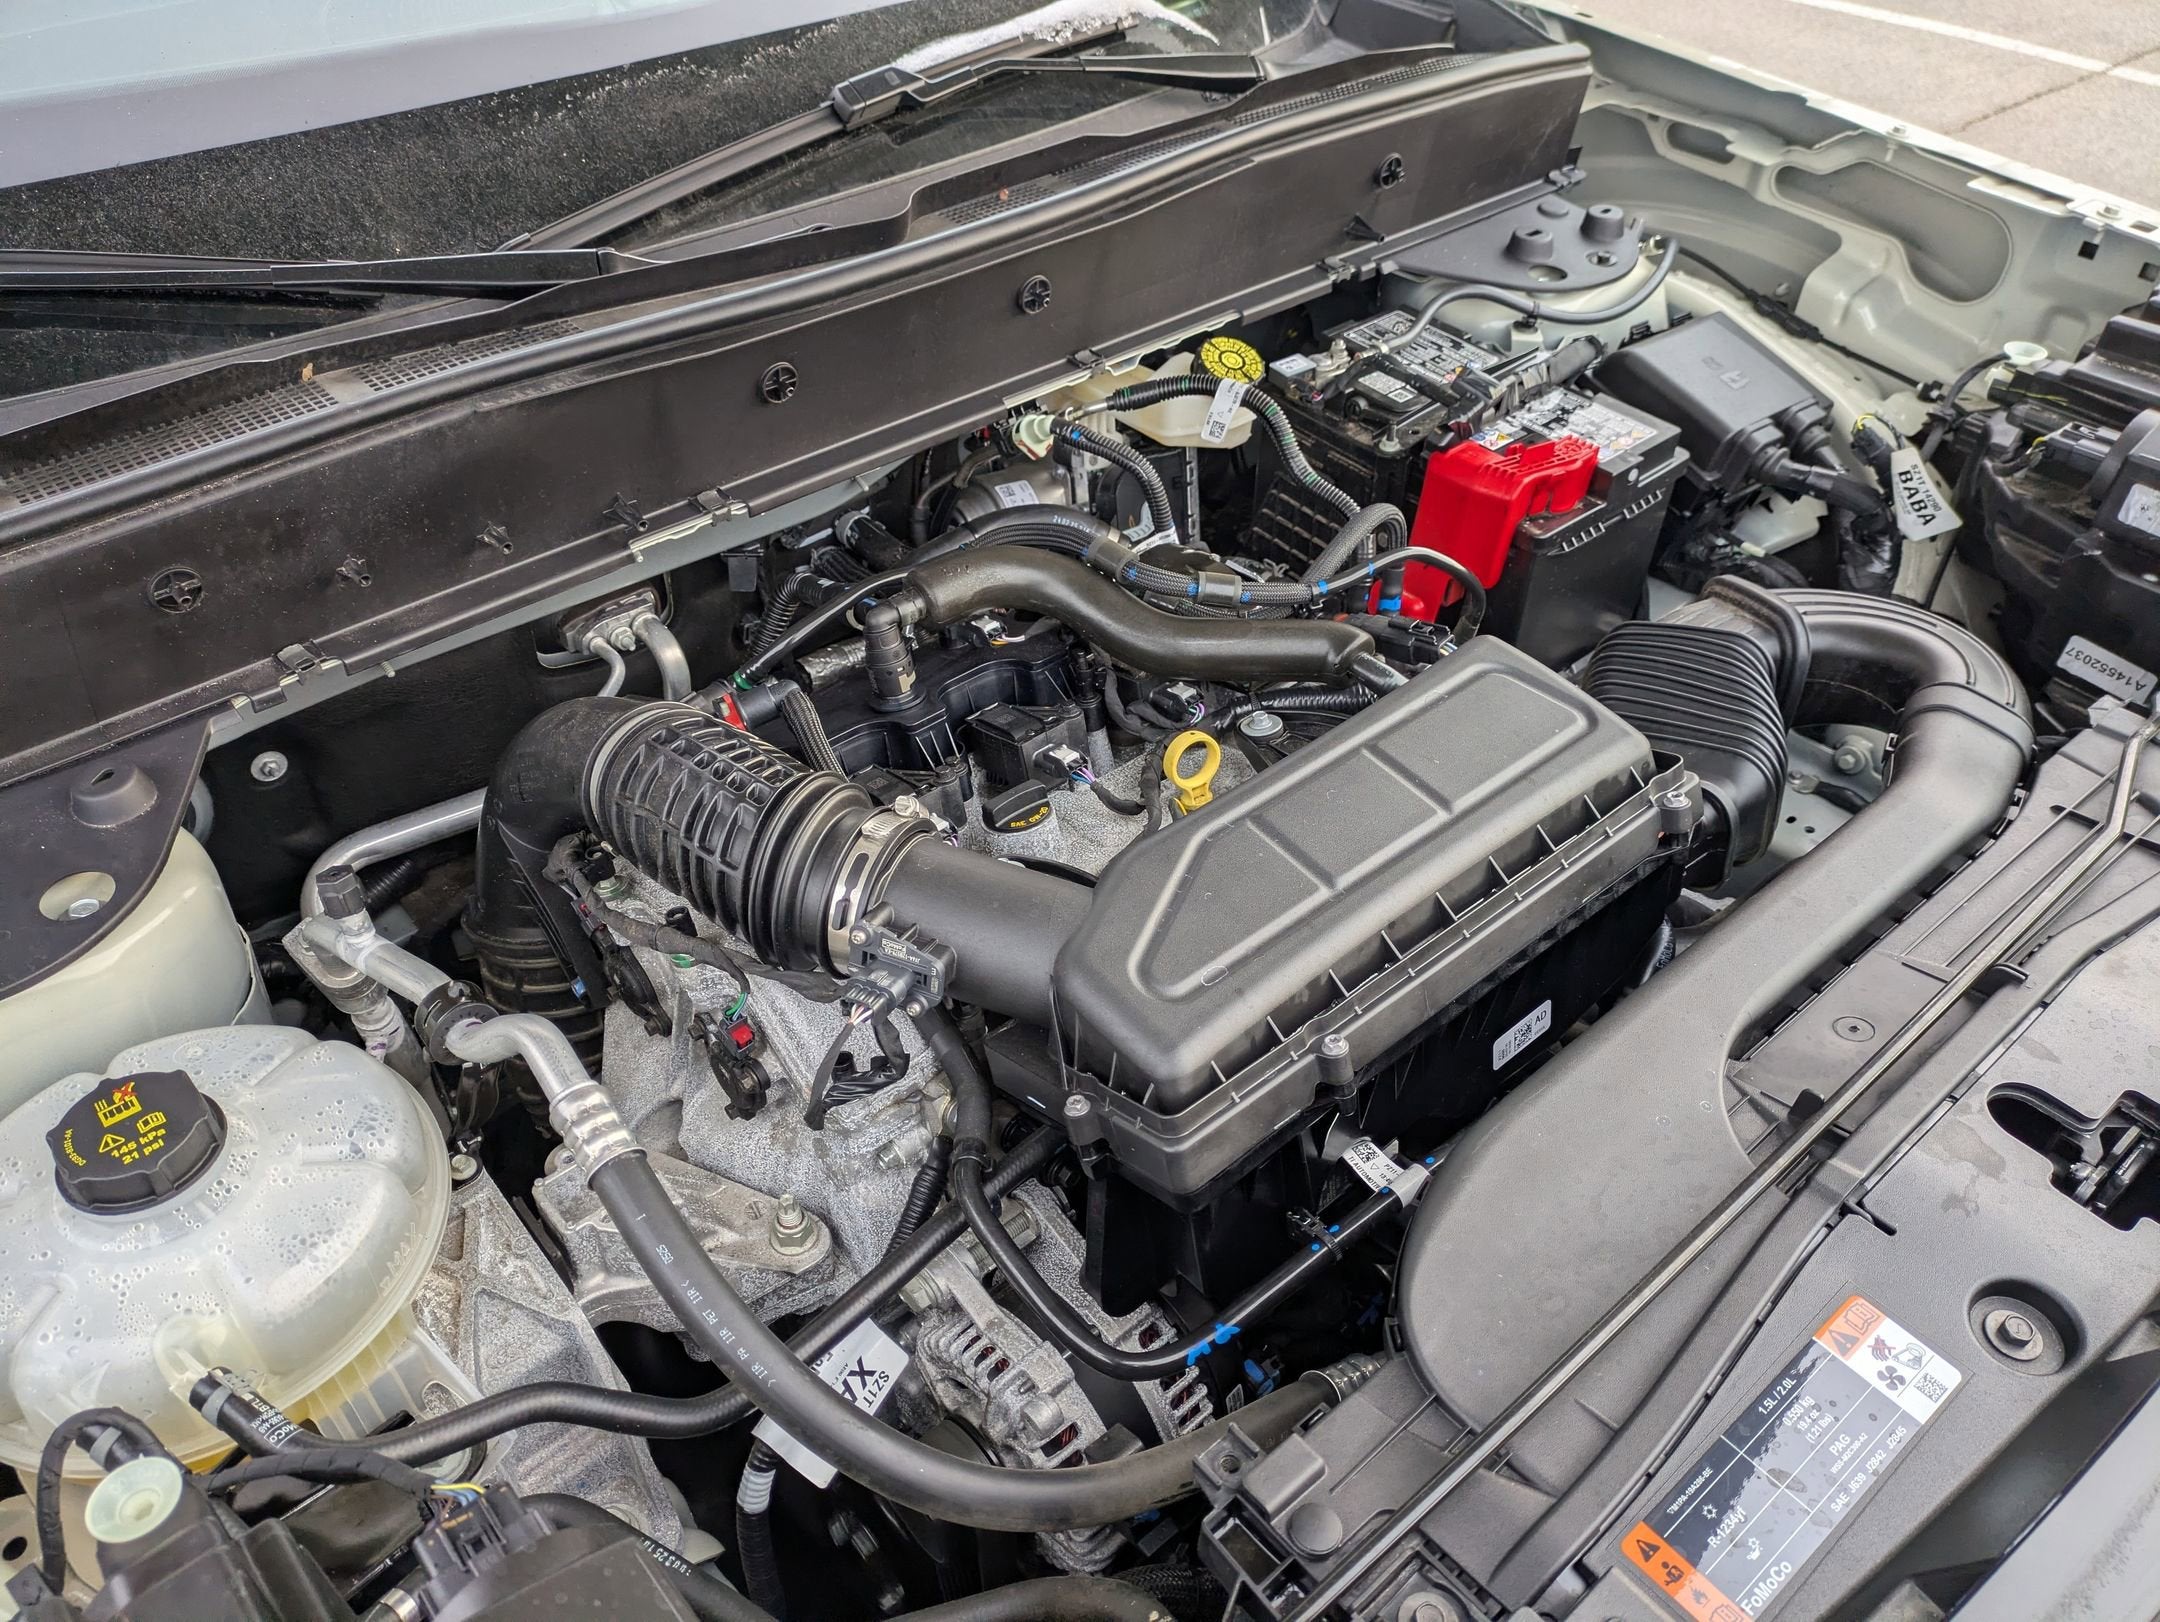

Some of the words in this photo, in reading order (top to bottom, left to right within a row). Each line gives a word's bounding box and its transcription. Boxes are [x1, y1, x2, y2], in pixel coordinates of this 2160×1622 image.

[1897, 470, 1937, 527] BABA
[2064, 646, 2147, 692] A14552037
[1533, 1009, 1547, 1026] AD
[111, 1141, 137, 1158] 145
[139, 1128, 167, 1145] kPa
[122, 1152, 140, 1165] 21
[143, 1138, 165, 1156] psi
[862, 1370, 890, 1409] SZ1T
[1758, 1397, 1779, 1415] 1.5L
[1776, 1377, 1797, 1396] 2.0L
[1782, 1403, 1805, 1426] 0.550
[1799, 1395, 1816, 1408] kg
[1828, 1433, 1852, 1456] PAG
[1830, 1491, 1850, 1513] SAE
[1847, 1471, 1867, 1494] J639
[1865, 1449, 1887, 1473] J2842
[1886, 1425, 1907, 1450] J2845
[1706, 1504, 1747, 1548] R-1234yf
[1740, 1560, 1793, 1616] FoMoCo
